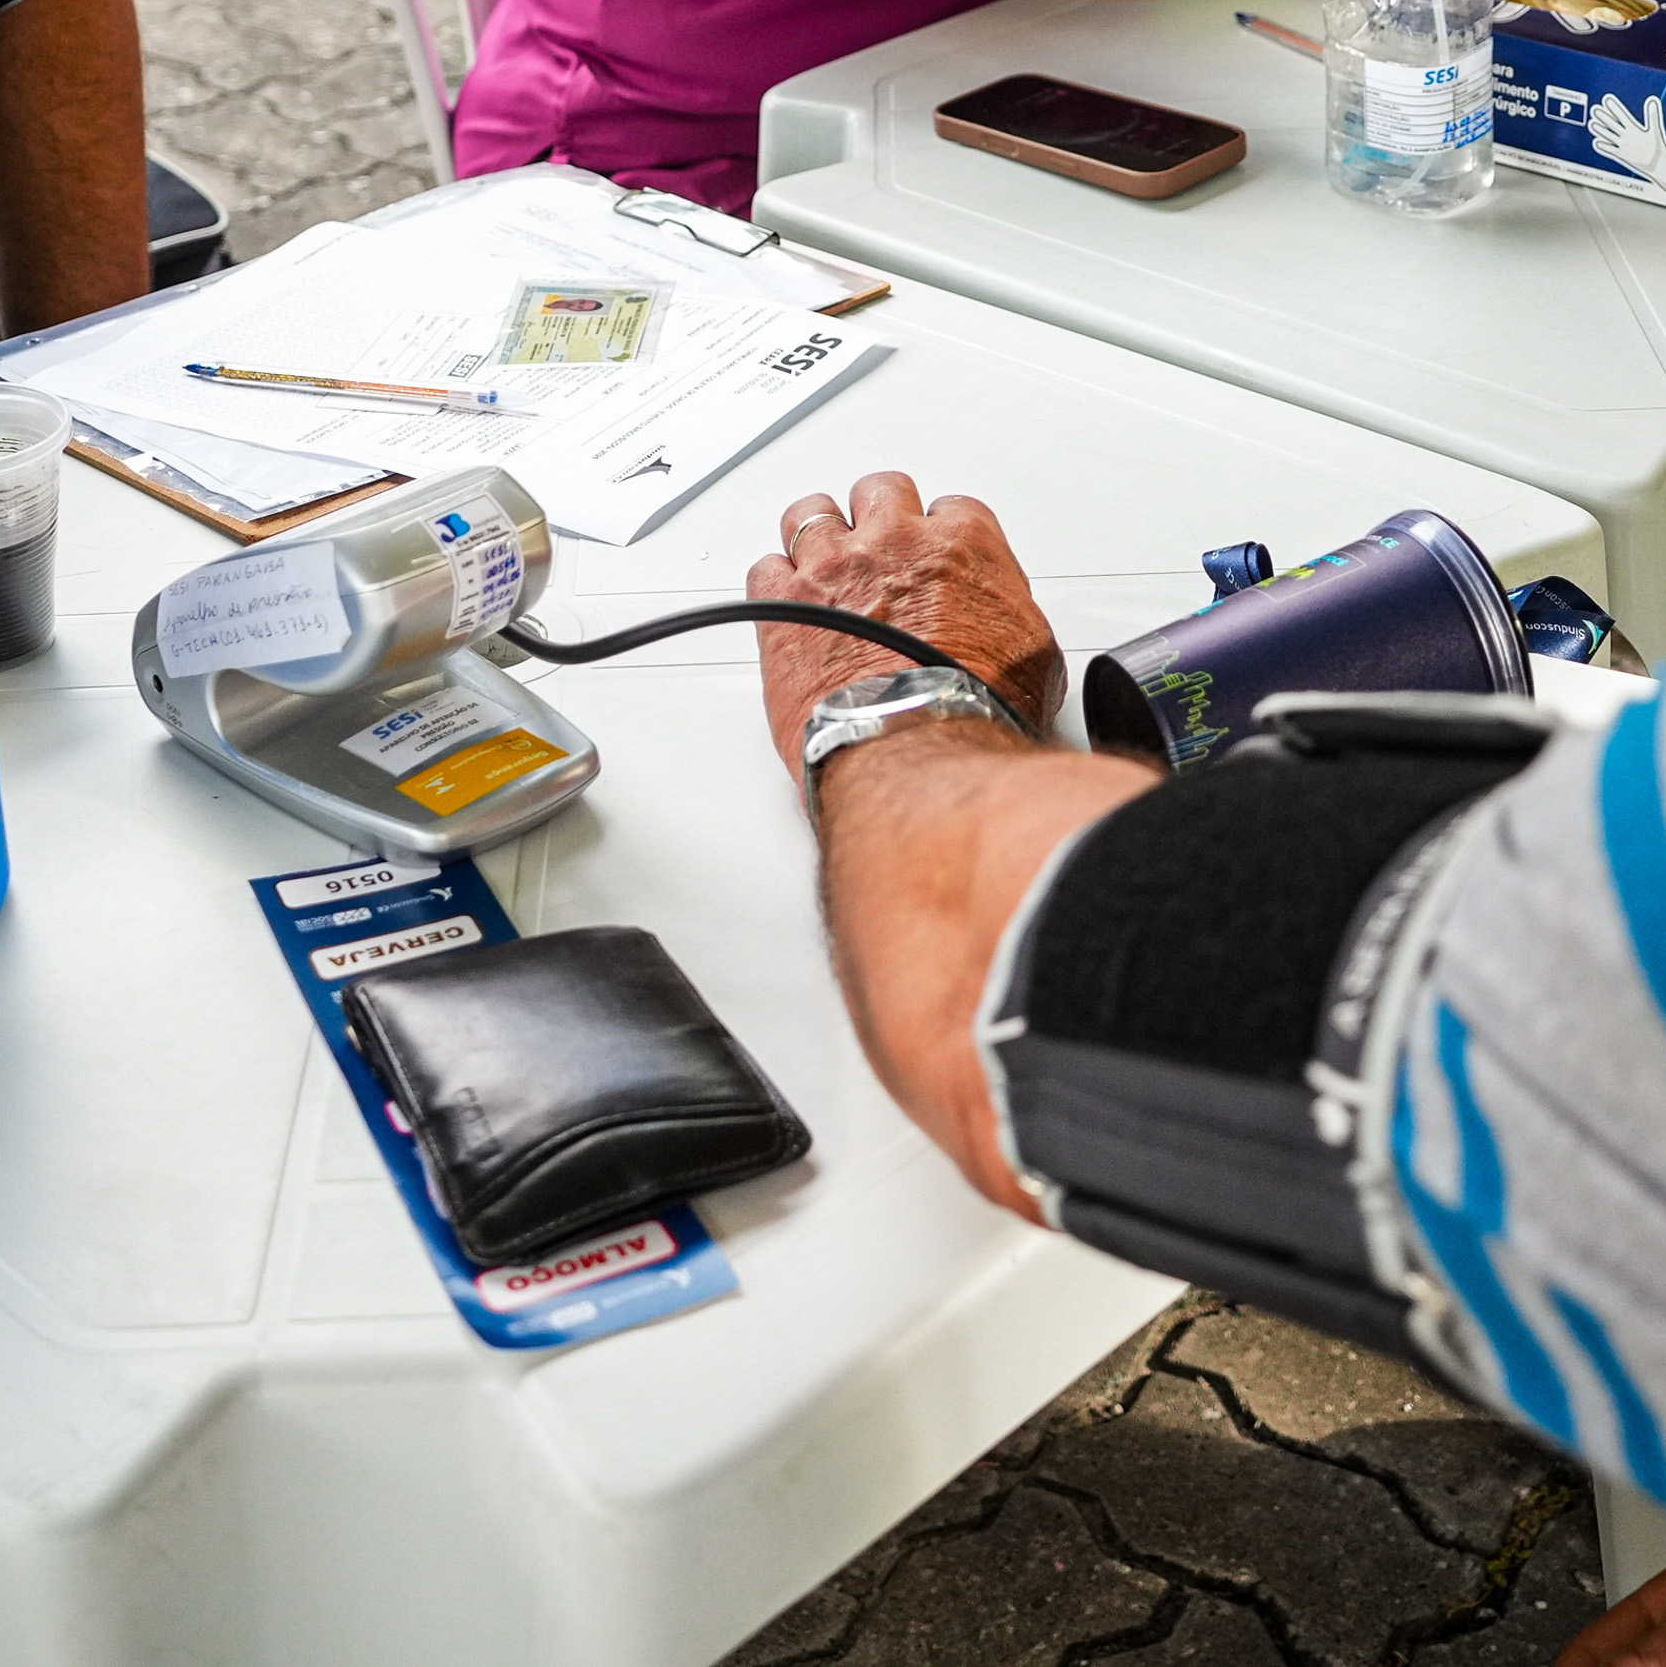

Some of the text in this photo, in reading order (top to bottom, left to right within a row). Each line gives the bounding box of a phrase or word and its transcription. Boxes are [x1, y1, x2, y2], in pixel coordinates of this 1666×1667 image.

[1493, 63, 1514, 79] ara
[1493, 91, 1538, 119] rúrgico
[1559, 101, 1572, 117] P
[452, 355, 481, 378] SESI
[1524, 622, 1587, 641] Sinduscon
[325, 869, 395, 894] 0516
[327, 925, 466, 967] CERVEJA
[506, 1234, 647, 1291] ALMOÇO
